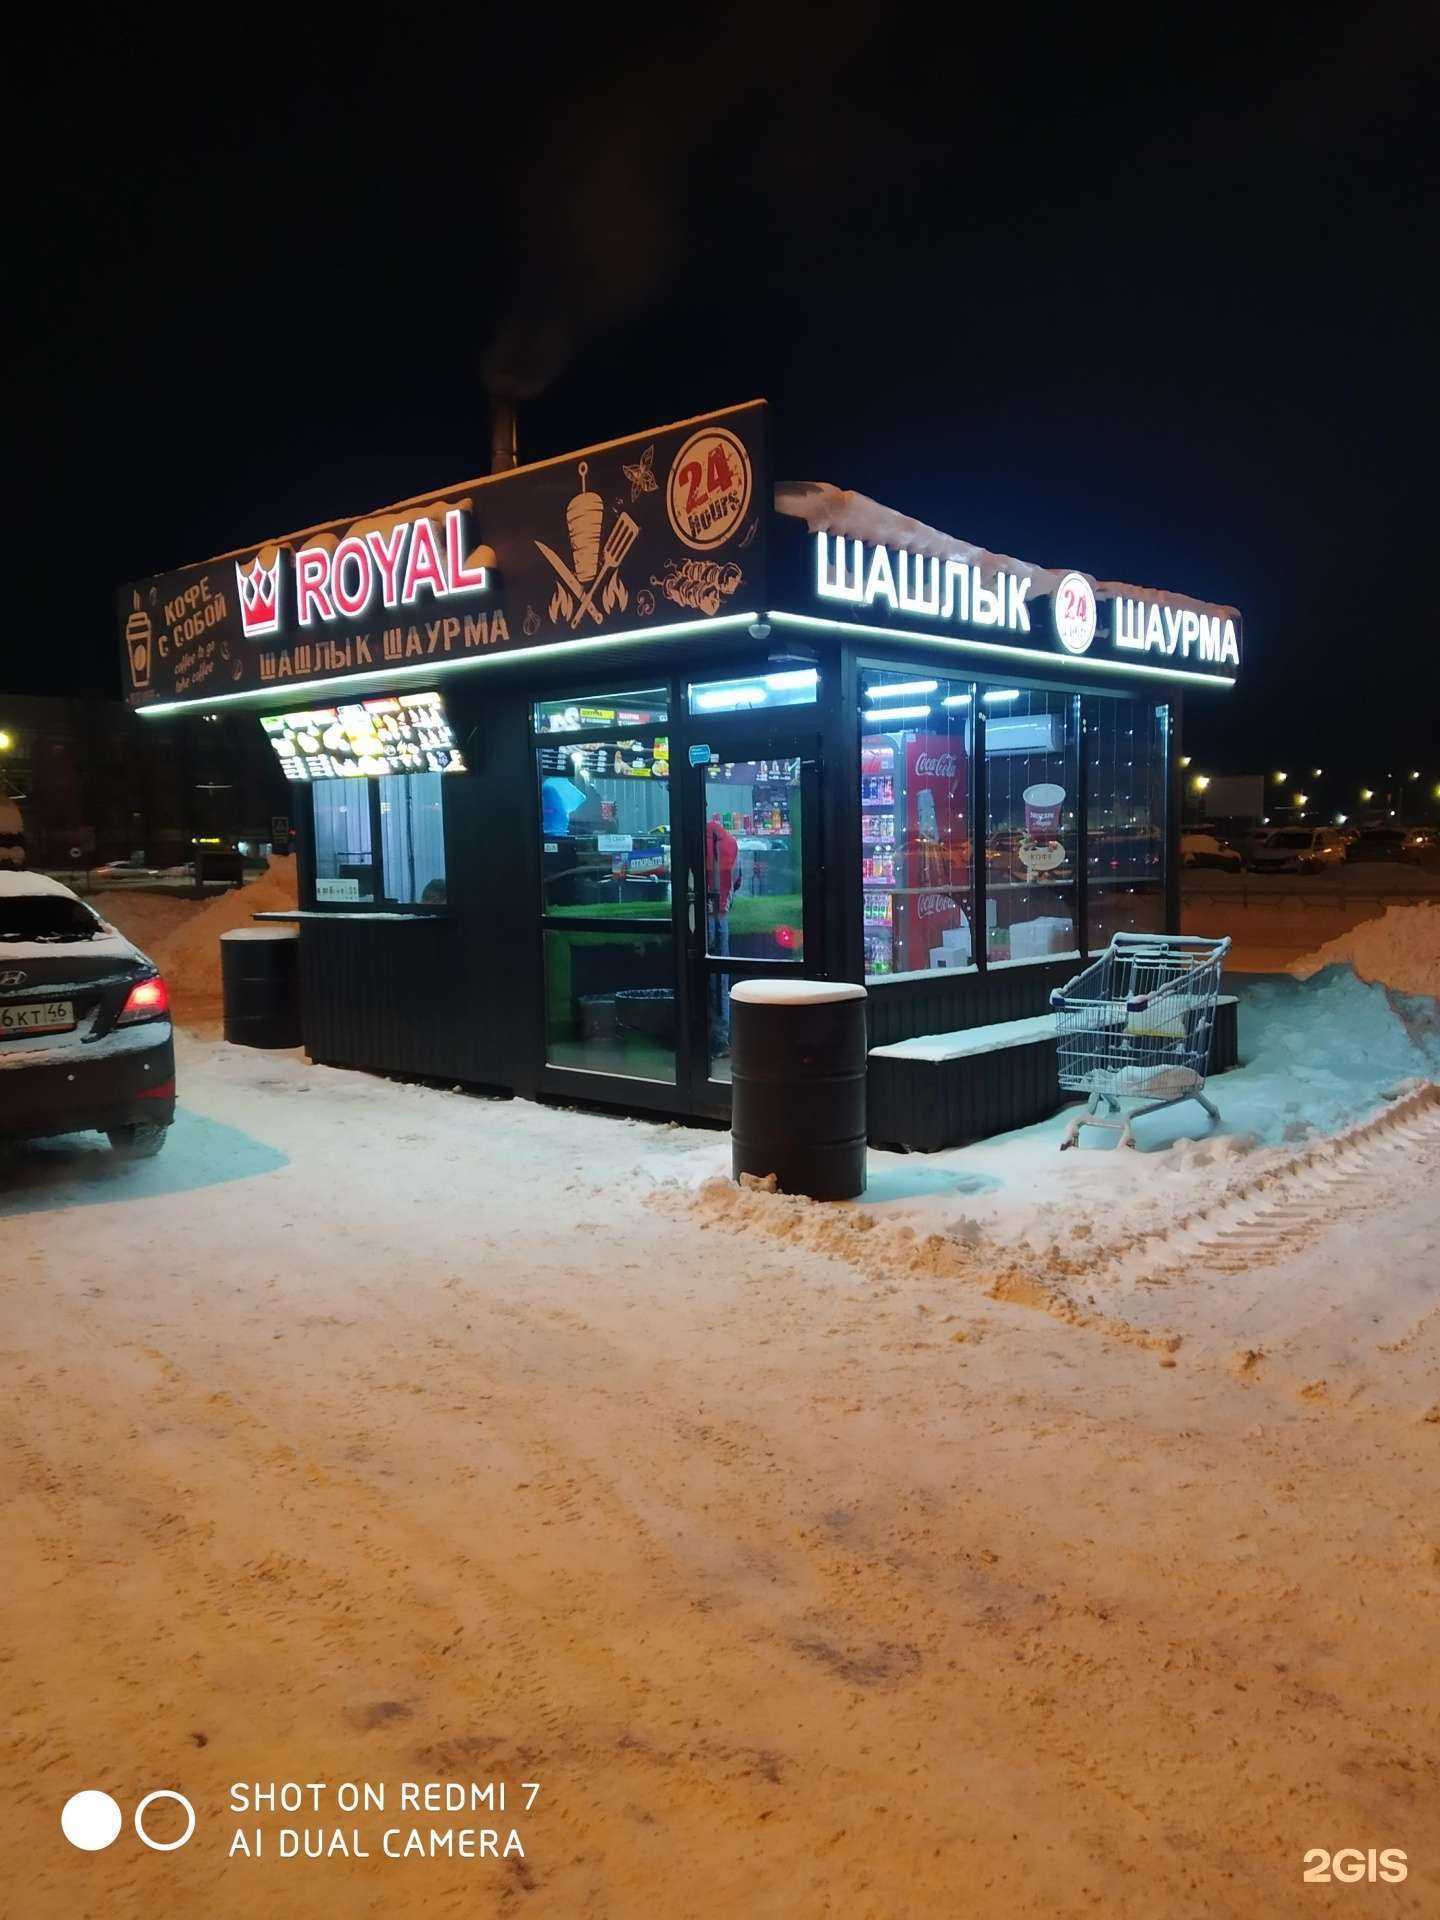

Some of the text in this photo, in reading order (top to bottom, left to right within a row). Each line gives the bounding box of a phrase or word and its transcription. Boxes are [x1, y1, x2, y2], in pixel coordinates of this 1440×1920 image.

[678, 443, 733, 514] 24
[164, 575, 212, 626] КОФЕ
[295, 509, 487, 626] ROYAL
[816, 530, 1032, 632] ШАШЛЫК
[158, 592, 227, 657] С СОБОЙ
[1064, 588, 1088, 622] 24
[1115, 595, 1240, 665] ШАУРМА
[259, 609, 510, 681] ШАШЛЫК ШАУРМА
